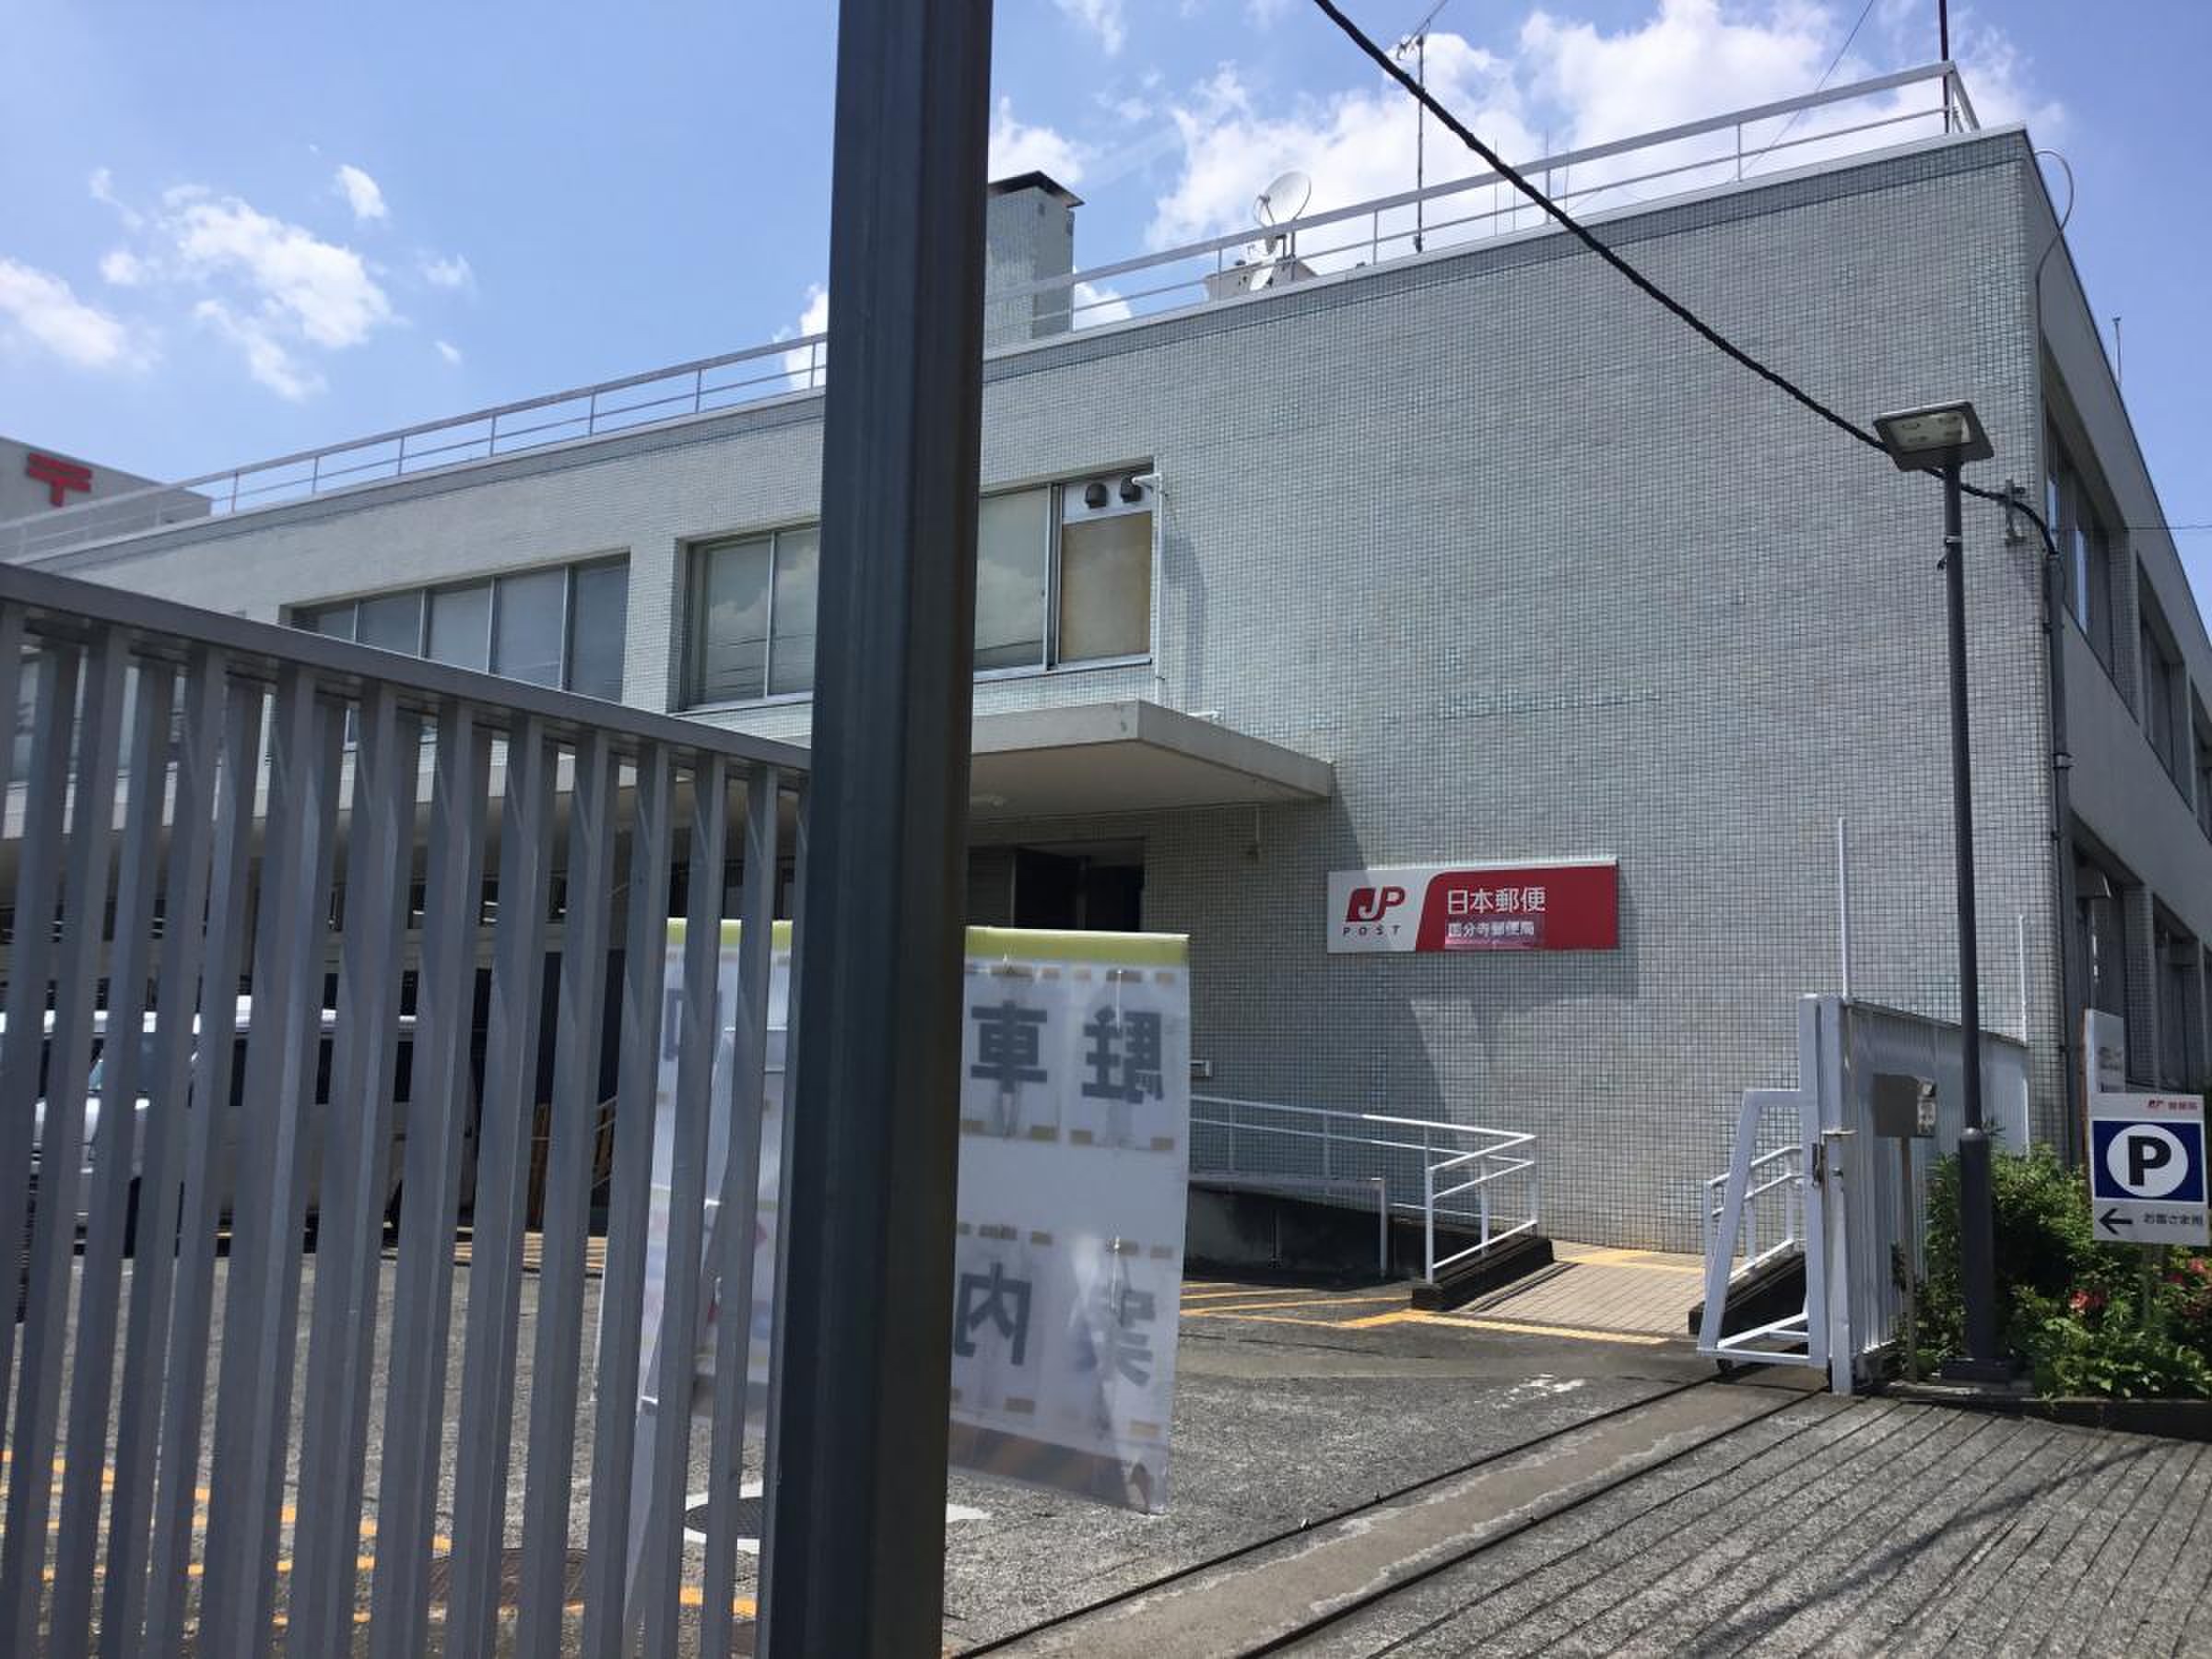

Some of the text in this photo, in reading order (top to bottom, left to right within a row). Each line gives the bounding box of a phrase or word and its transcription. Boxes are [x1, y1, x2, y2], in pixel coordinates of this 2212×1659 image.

[1345, 886, 1406, 923] JP
[1447, 886, 1547, 915] 日本郵便
[1342, 924, 1401, 936] POST
[2127, 1135, 2172, 1187] P
